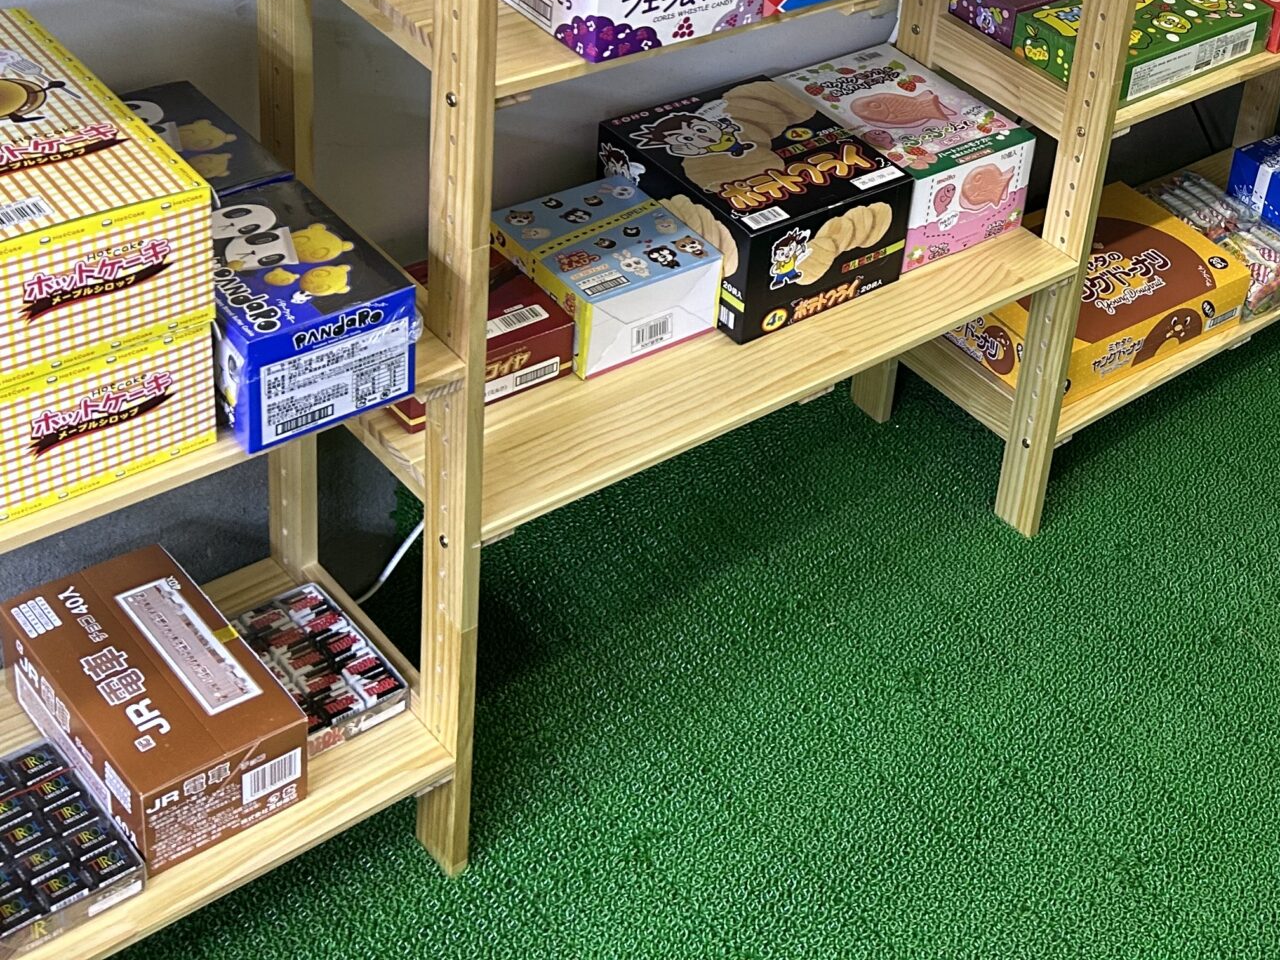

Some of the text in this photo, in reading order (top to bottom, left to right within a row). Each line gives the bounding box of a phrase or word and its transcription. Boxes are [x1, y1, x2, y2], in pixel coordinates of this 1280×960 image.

[652, 11, 677, 24] CORIS
[677, 4, 711, 18] WHISTLE
[1025, 46, 1048, 61] アップル
[611, 96, 701, 126] TOHO SEIKA
[719, 144, 878, 211] ポテトフライ
[620, 205, 648, 222] OPEN
[23, 240, 171, 303] ホットケーキ
[51, 275, 137, 306] メープルシロップ
[792, 279, 862, 322] ポテトフライ
[1095, 275, 1167, 316] Young Doughnut
[31, 371, 173, 439] ホットケーキ
[58, 406, 140, 440] メープルシロップ
[20, 750, 56, 772] TIROL
[35, 775, 72, 798] TIROL
[52, 799, 91, 823] TIROL
[6, 821, 45, 844] TIROL
[71, 823, 110, 846] TIROL
[87, 848, 128, 873] TIROL
[39, 871, 80, 894] TIROL
